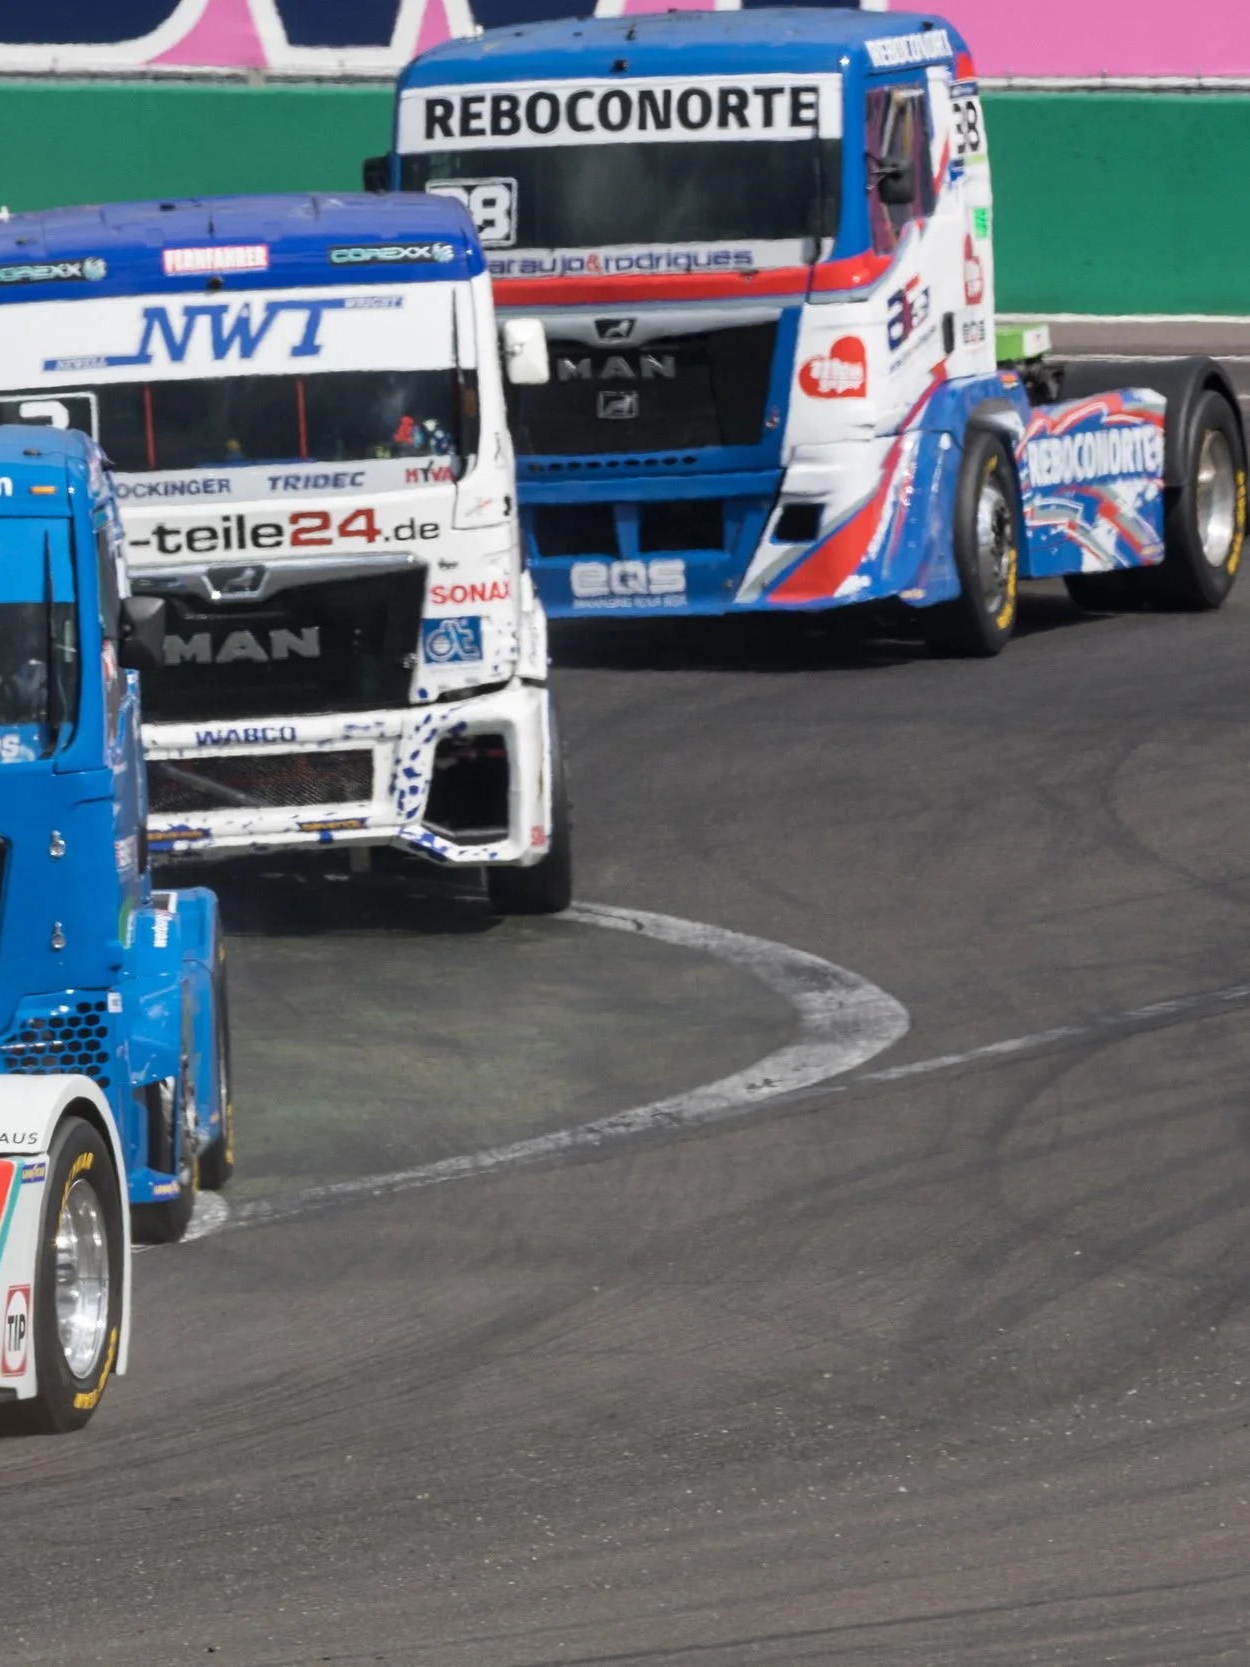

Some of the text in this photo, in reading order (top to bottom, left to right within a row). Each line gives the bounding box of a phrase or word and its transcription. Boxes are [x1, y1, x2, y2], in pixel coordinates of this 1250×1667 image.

[424, 86, 820, 140] REBOCONORTE
[139, 303, 324, 362] NWT
[556, 355, 676, 381] MAN
[114, 478, 232, 499] OCKINGER
[267, 472, 367, 491] TRIDEC
[162, 627, 321, 665] MAN
[195, 726, 297, 746] WABCO
[7, 1315, 25, 1352] TIP
